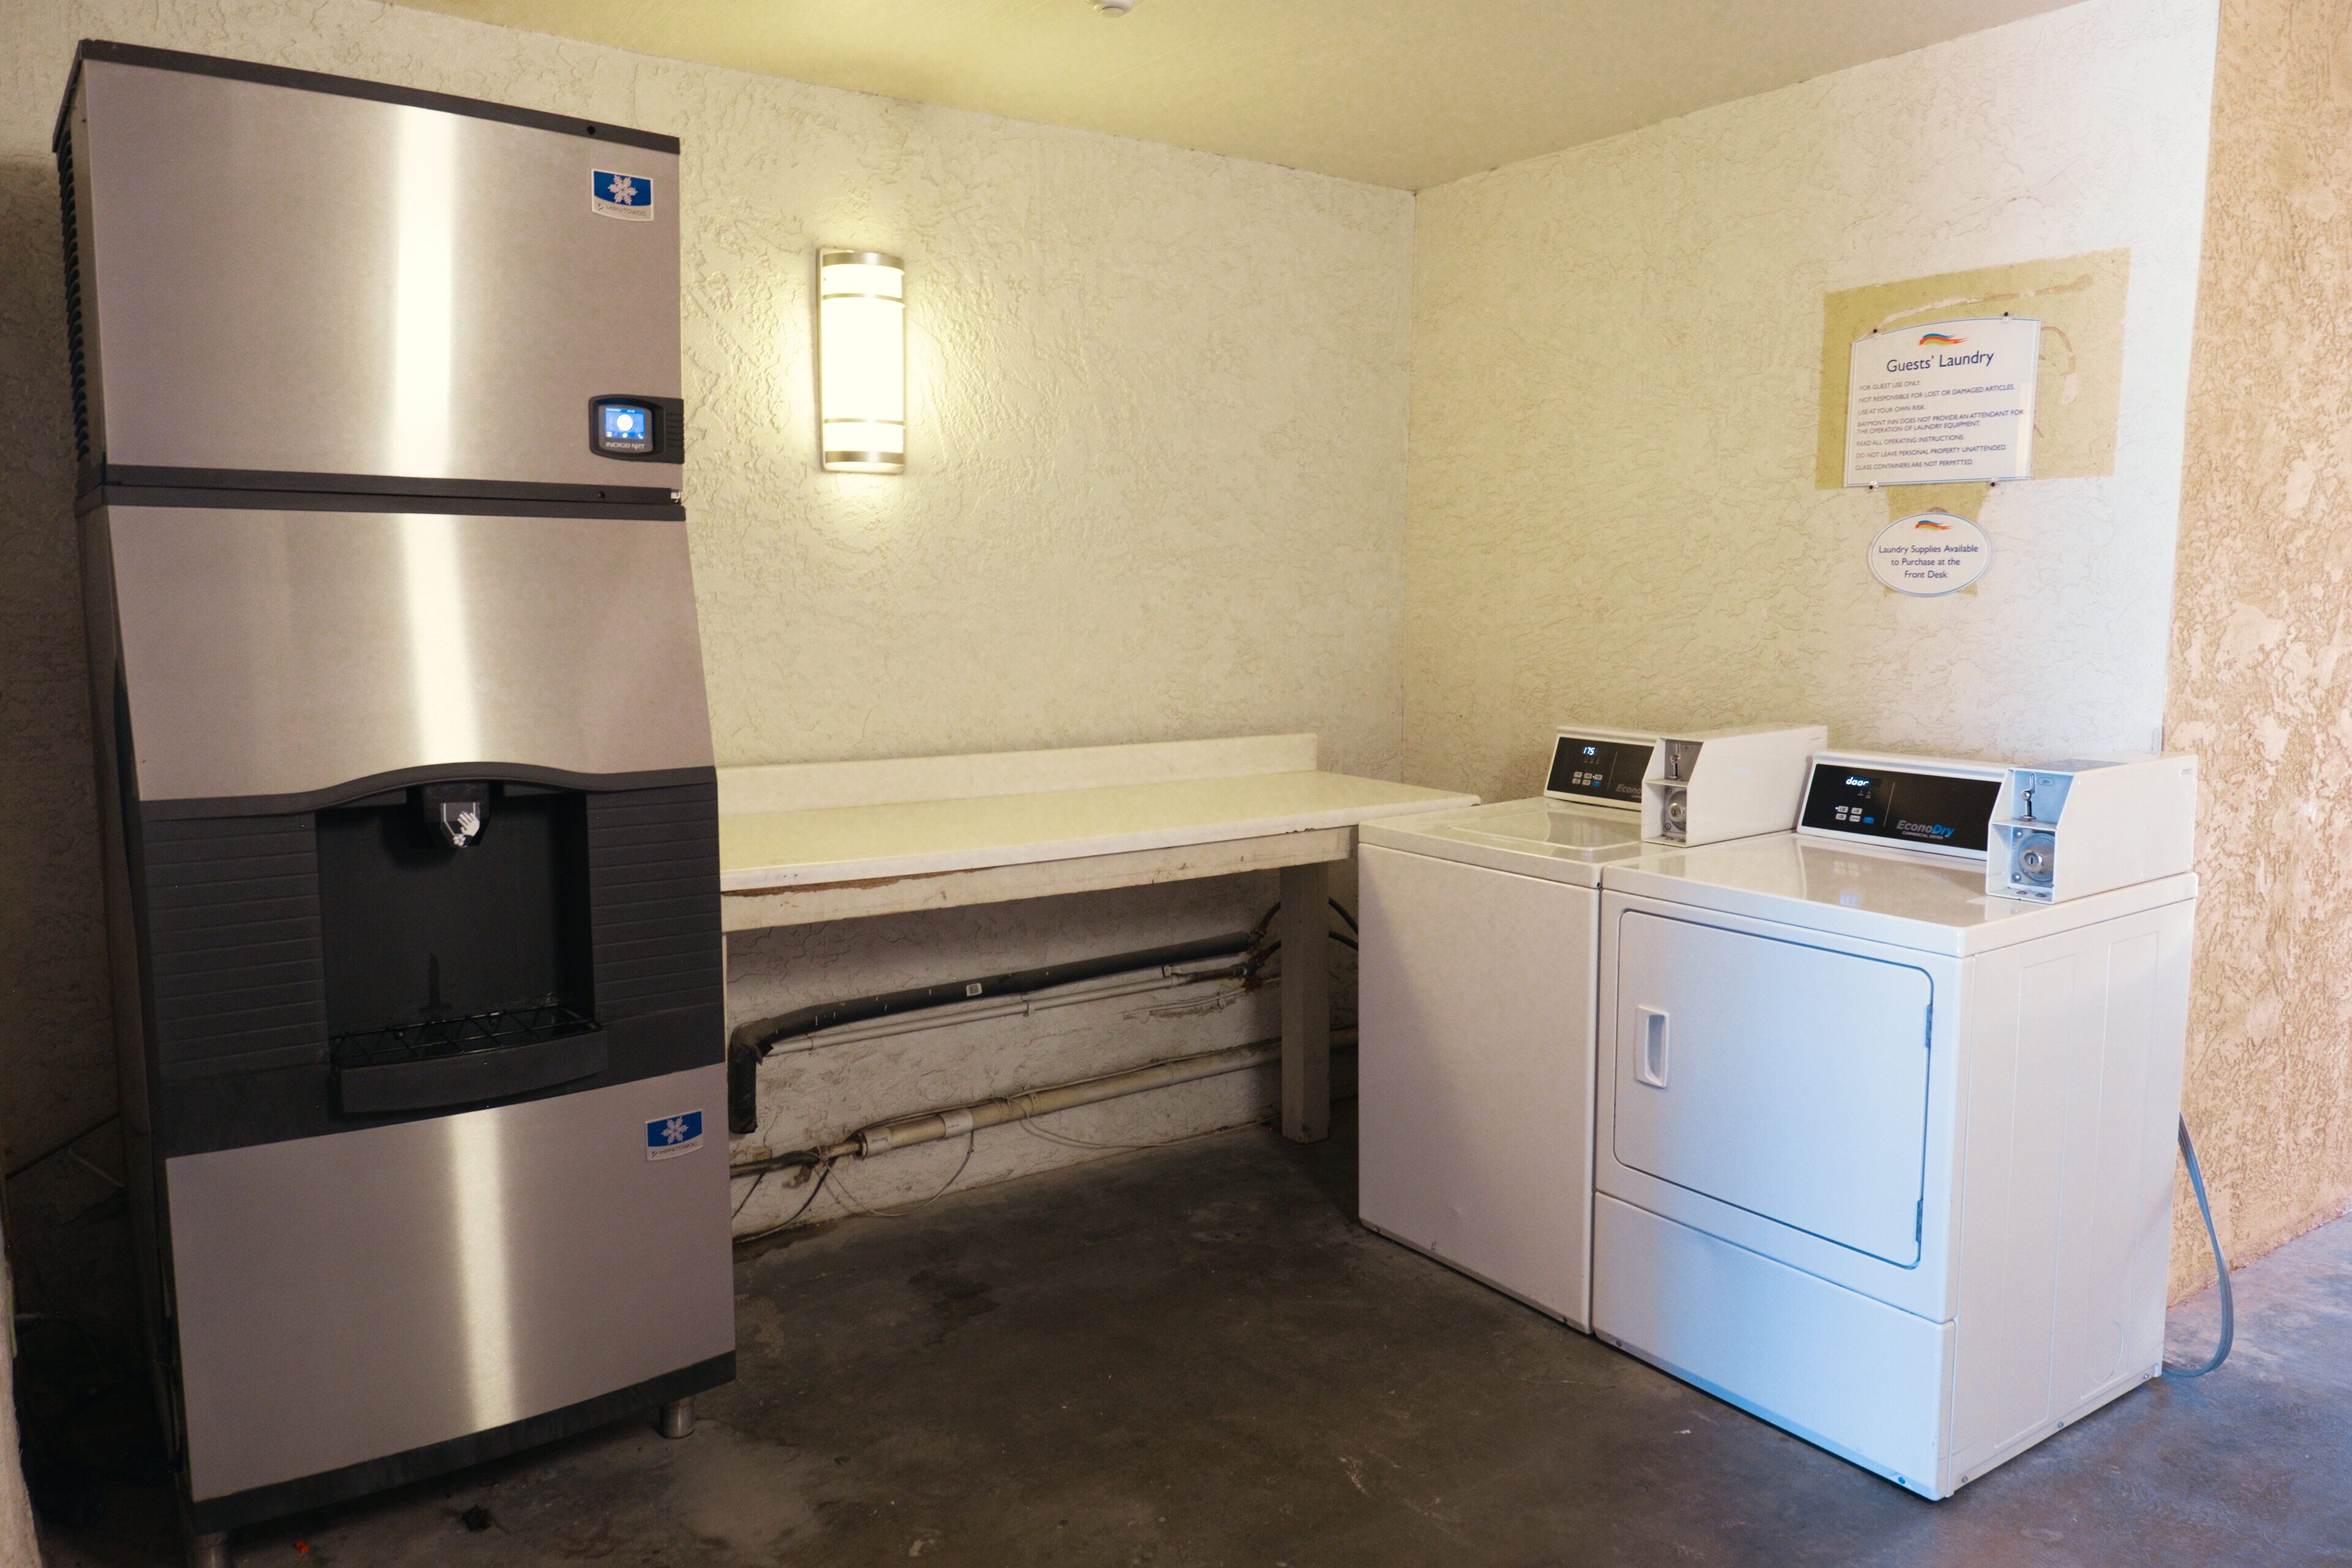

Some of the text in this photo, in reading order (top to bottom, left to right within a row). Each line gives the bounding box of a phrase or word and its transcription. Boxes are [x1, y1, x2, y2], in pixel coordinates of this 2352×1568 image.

[1939, 350, 1995, 368] Laundry
[1873, 393, 1910, 402] RESPONSIBLE
[1952, 386, 1984, 395] DAMAGED
[1970, 410, 2009, 418] ATTENDANT
[1879, 544, 1978, 555] Laundry Supplies Available
[1927, 570, 1948, 578] Desk
[1583, 746, 1596, 756] 175
[1845, 776, 1870, 786] door
[1896, 820, 1956, 838] EconoDry
